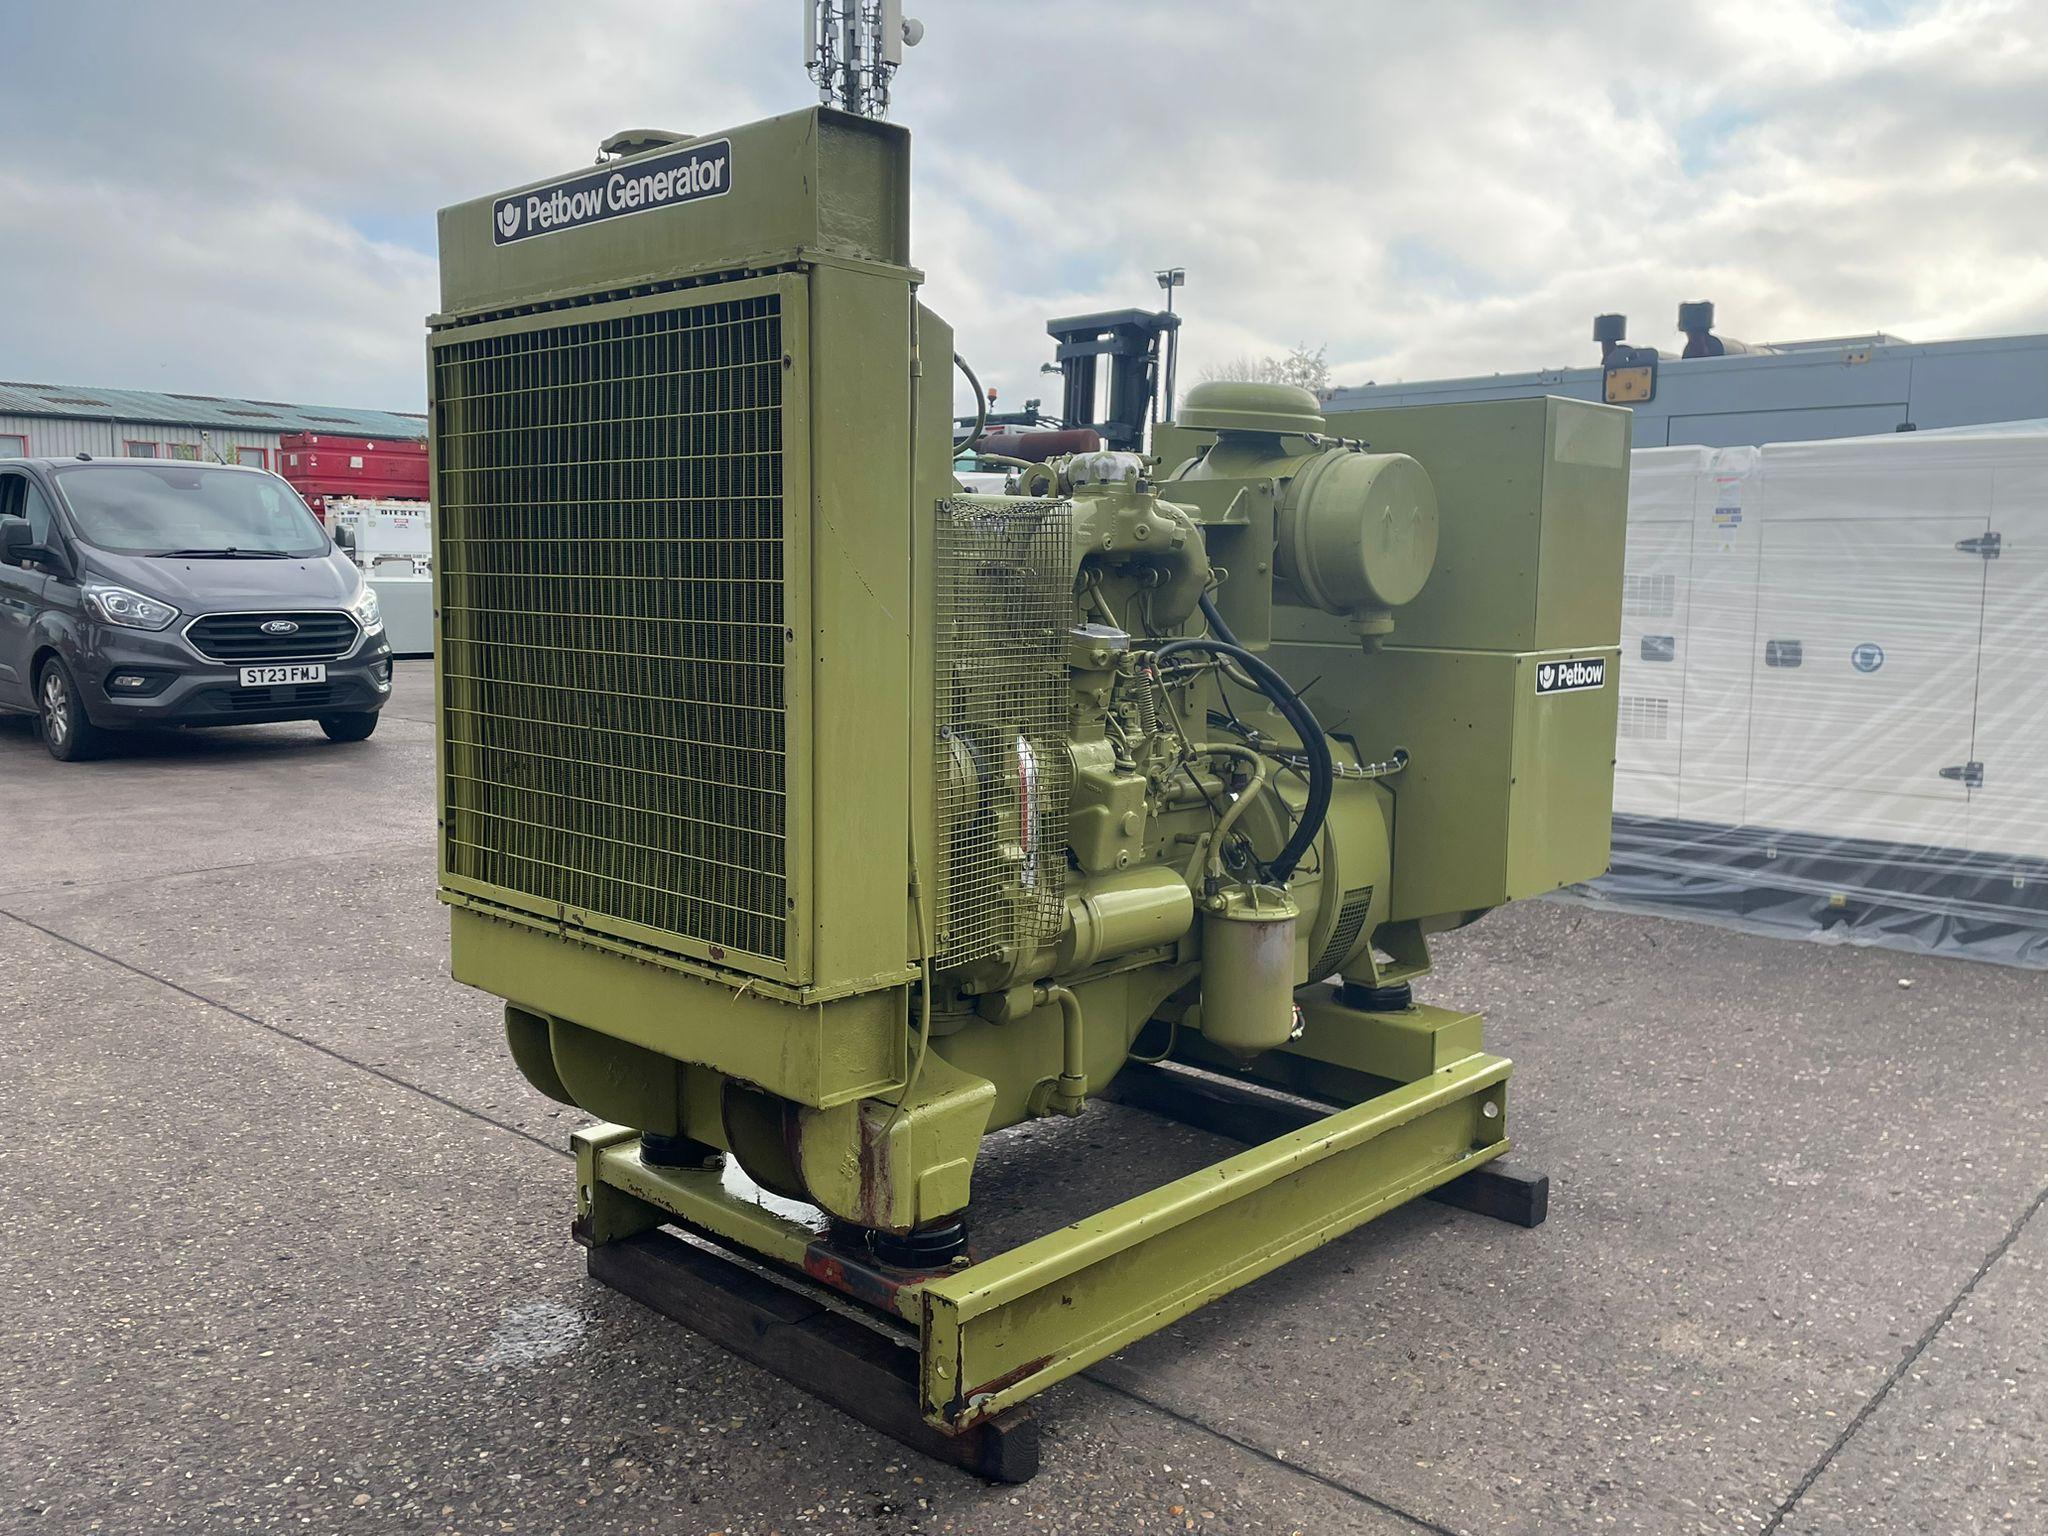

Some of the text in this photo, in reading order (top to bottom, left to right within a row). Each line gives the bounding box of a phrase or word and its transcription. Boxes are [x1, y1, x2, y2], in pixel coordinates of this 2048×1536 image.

[526, 156, 725, 231] Petbow Generator
[270, 622, 291, 631] Ford
[247, 666, 319, 683] ST23 FMJ
[1557, 662, 1603, 687] Petbow
